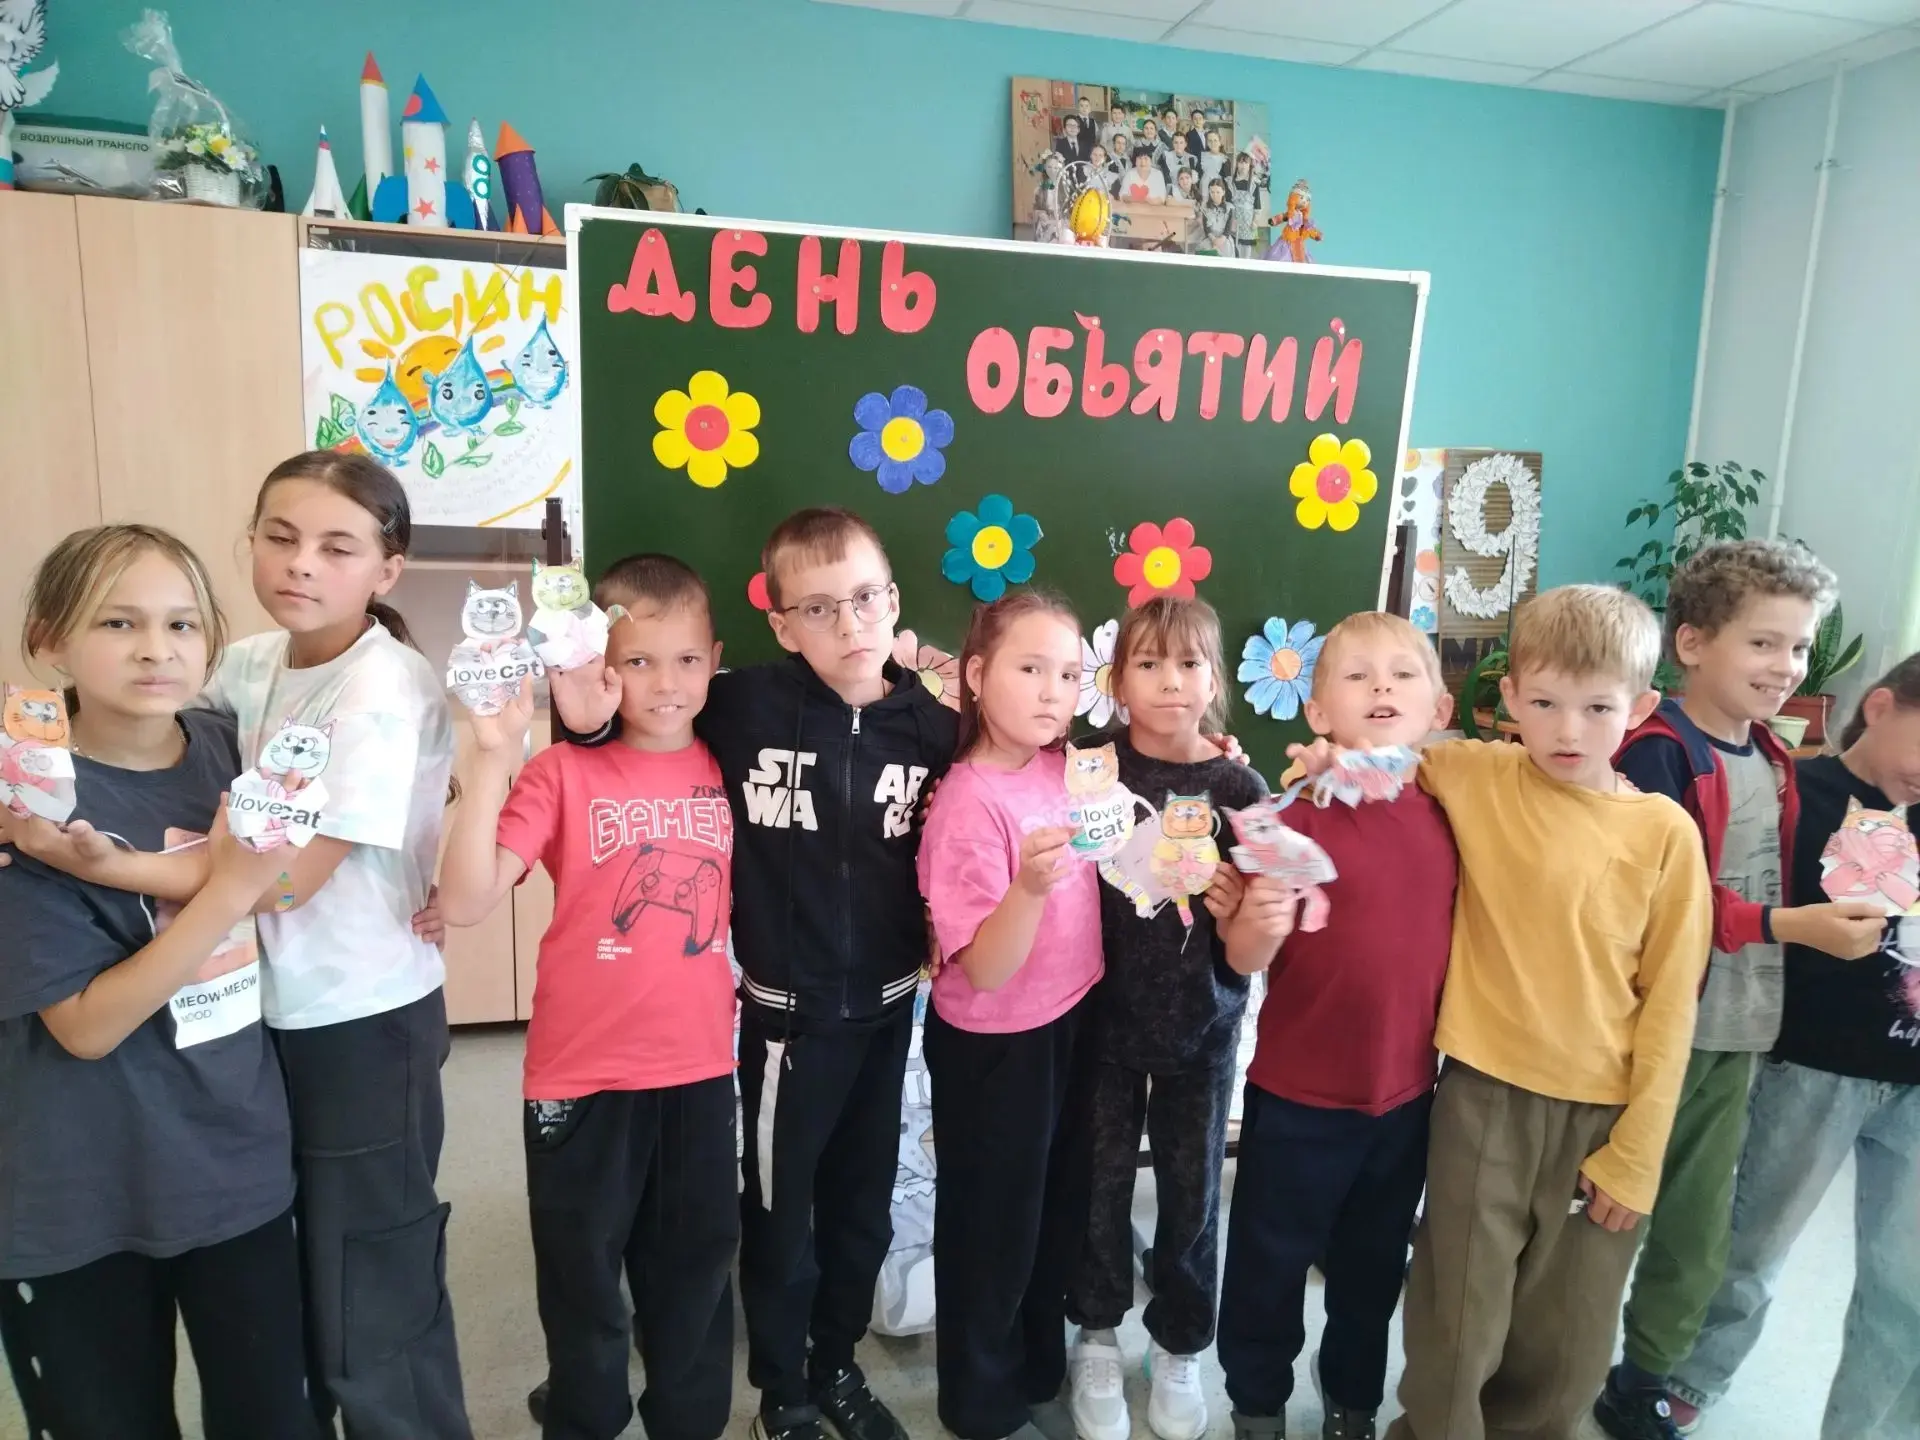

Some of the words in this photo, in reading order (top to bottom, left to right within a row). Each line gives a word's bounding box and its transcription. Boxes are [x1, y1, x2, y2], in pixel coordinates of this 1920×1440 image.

[20, 132, 94, 147] ВОЗДУШНЫЙ
[97, 139, 149, 152] ТРАНСПО
[607, 227, 937, 335] ДЕНЬ
[313, 264, 563, 370] РОСИН
[966, 310, 1363, 424] ОБЪЯТИЙ
[1444, 452, 1543, 620] 9
[454, 666, 497, 683] love
[500, 660, 541, 679] cat
[749, 748, 818, 789] ST
[234, 793, 284, 815] love
[742, 781, 819, 831] WA
[1083, 803, 1123, 823] love
[1088, 817, 1125, 841] cat
[174, 973, 258, 1009] MEOW-MEOW
